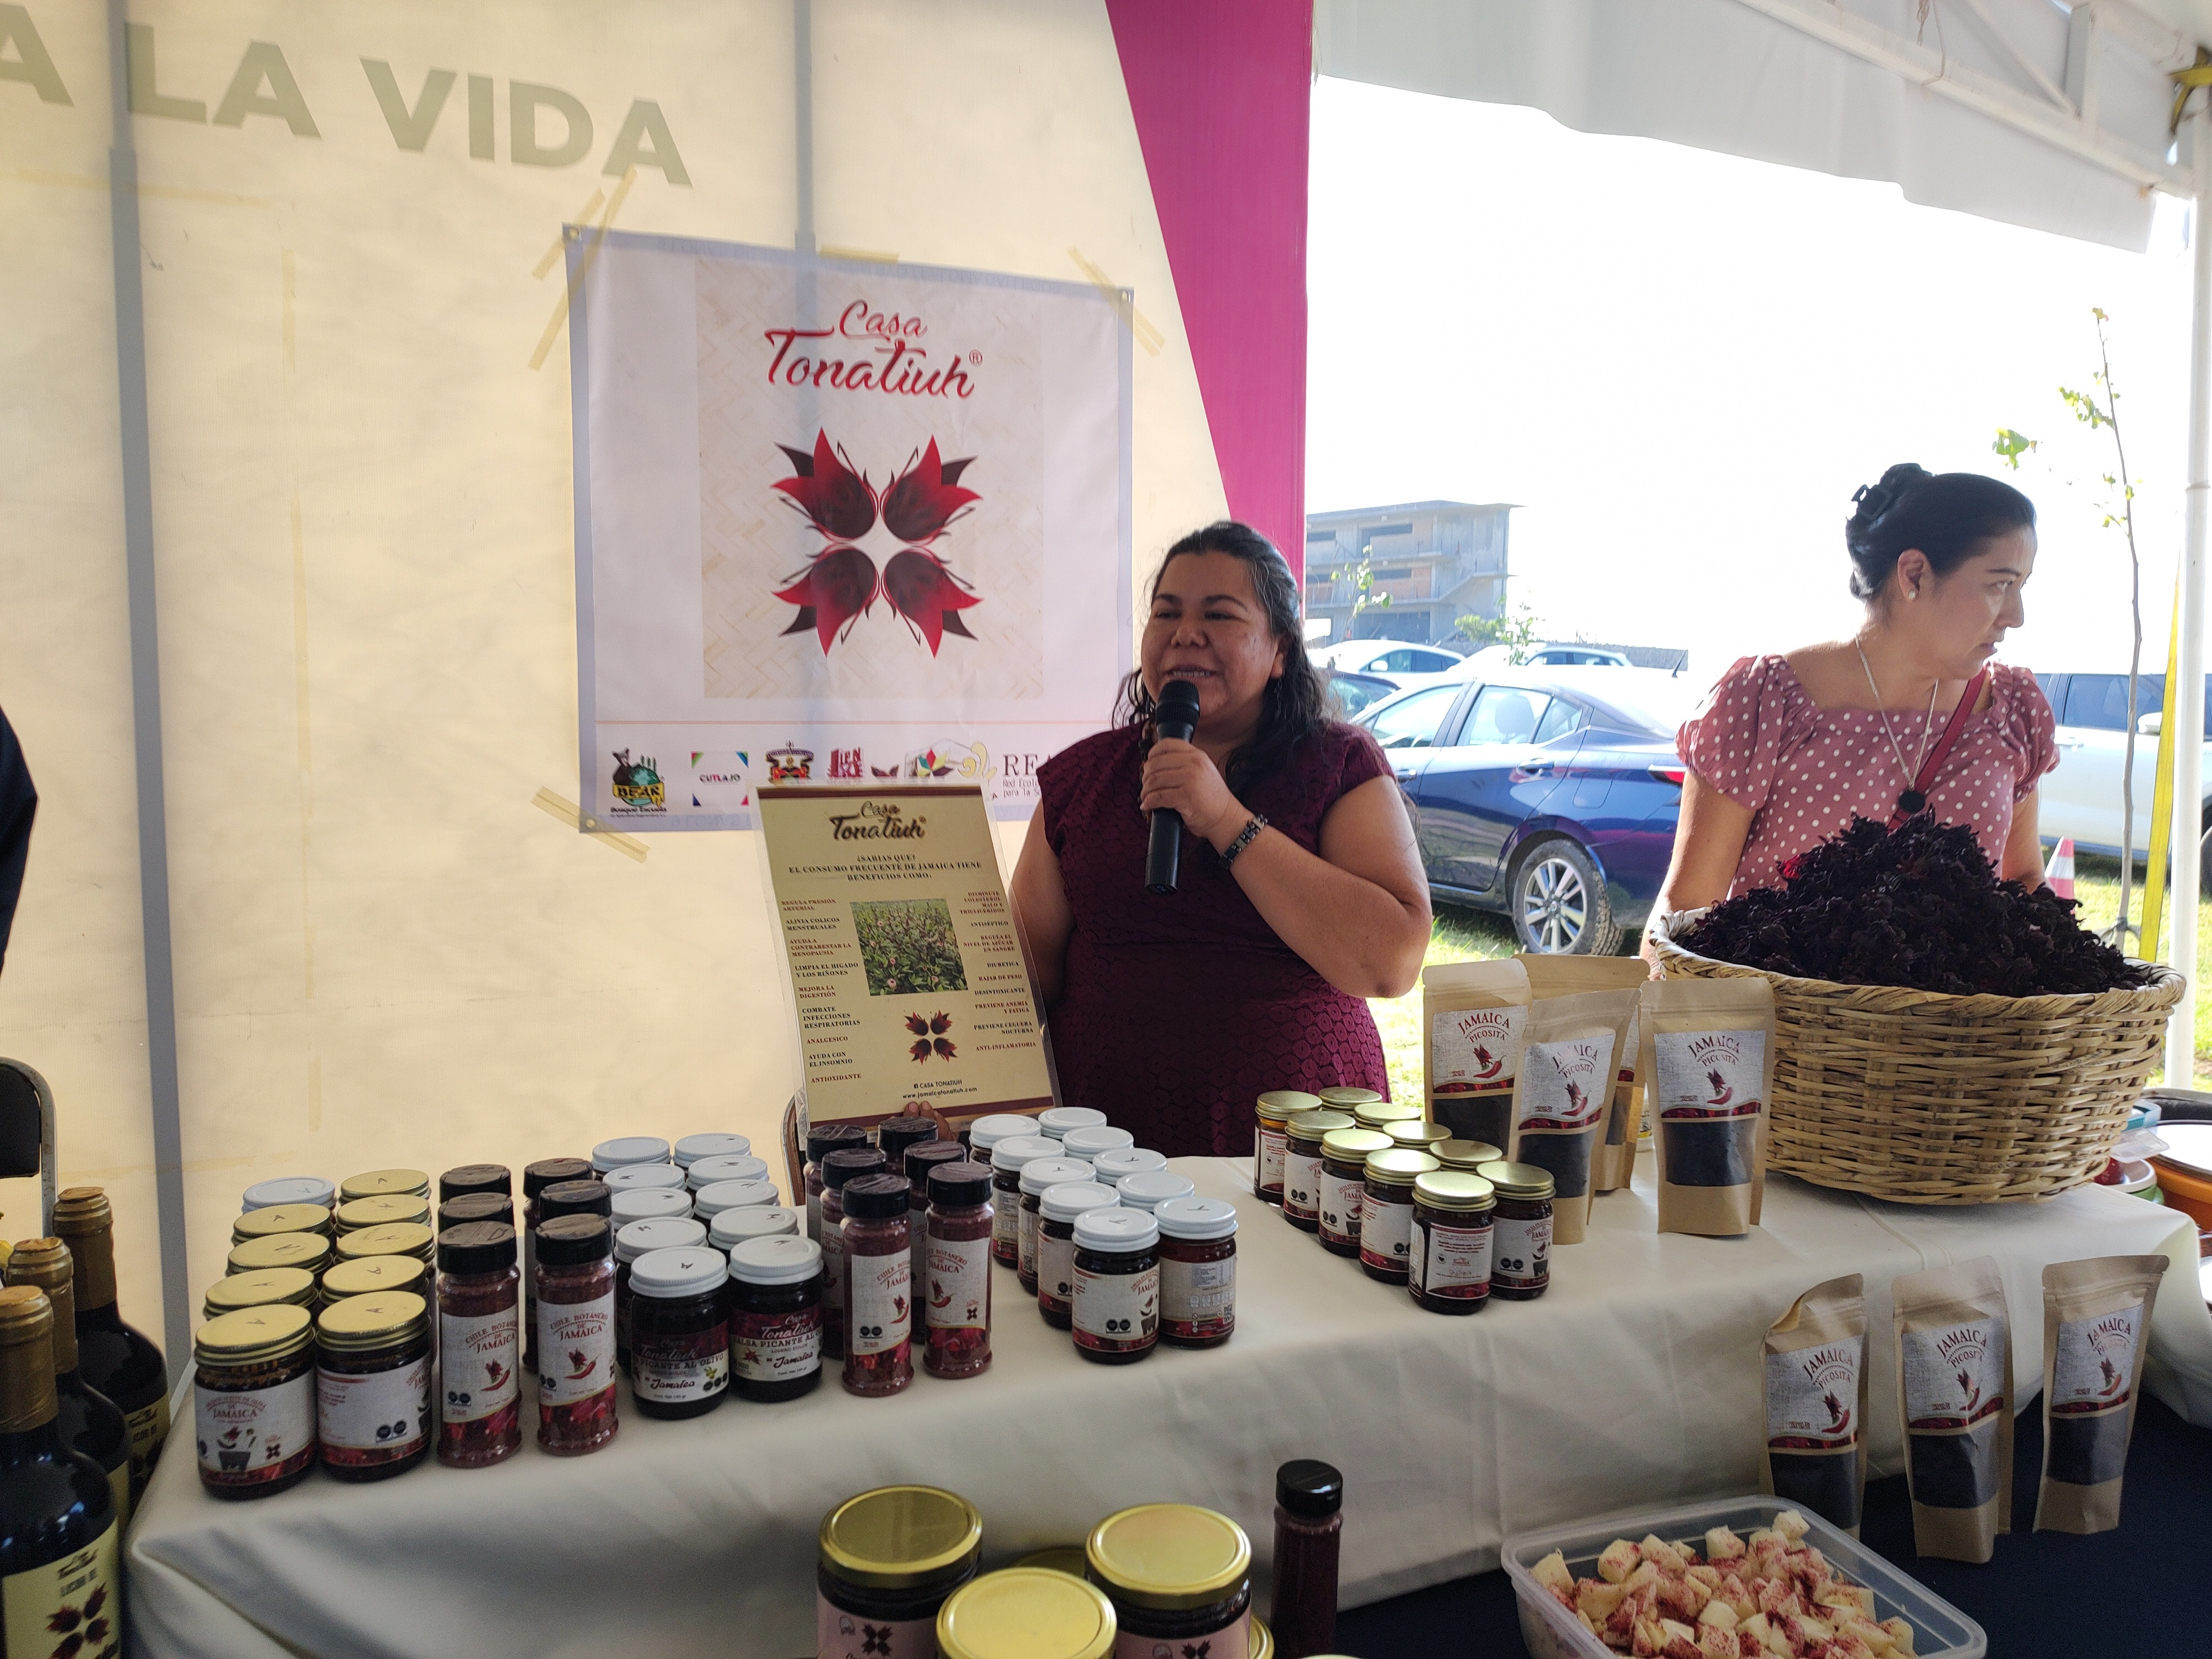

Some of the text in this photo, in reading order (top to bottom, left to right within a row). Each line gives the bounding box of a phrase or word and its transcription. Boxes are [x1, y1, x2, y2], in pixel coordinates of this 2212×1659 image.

[124, 21, 324, 140] LA
[359, 55, 693, 189] VIDA
[839, 299, 928, 342] Casa
[699, 773, 741, 783] CUTLAJO
[860, 801, 901, 819] Casa
[802, 865, 847, 873] CONSUMO
[849, 863, 902, 872] FRECUENTE
[917, 862, 954, 870] JAMAICA
[847, 874, 901, 882] BENEFICIOS
[800, 990, 836, 999] DIGESTIÓN
[974, 987, 1026, 995] DESINTOXICANTE
[803, 1013, 851, 1021] INFECCIONES
[1458, 1011, 1510, 1035] JAMAICA
[804, 1019, 860, 1029] RESPIRATORIAS
[806, 1036, 848, 1044] ANALGESICO
[1469, 1030, 1505, 1043] PICOSITA
[1688, 1035, 1740, 1059] JAMAICA
[820, 1058, 853, 1066] INSOMNIO
[1563, 1063, 1593, 1078] PICOSITA
[811, 1073, 862, 1083] ANTIOXIDANTE
[550, 1317, 571, 1330] CHILE
[465, 1328, 488, 1344] CHILE
[560, 1324, 603, 1341] JAMAICA
[2086, 1317, 2131, 1348] JAMAICA
[477, 1332, 515, 1354] JAMAICA
[737, 1338, 758, 1347] ALSA
[760, 1337, 802, 1348] PICANTE
[1936, 1328, 1987, 1359] JAMAICA
[699, 1353, 724, 1366] OLIVO
[1803, 1348, 1854, 1382] JAMAICA
[213, 1410, 257, 1419] JAMAICA
